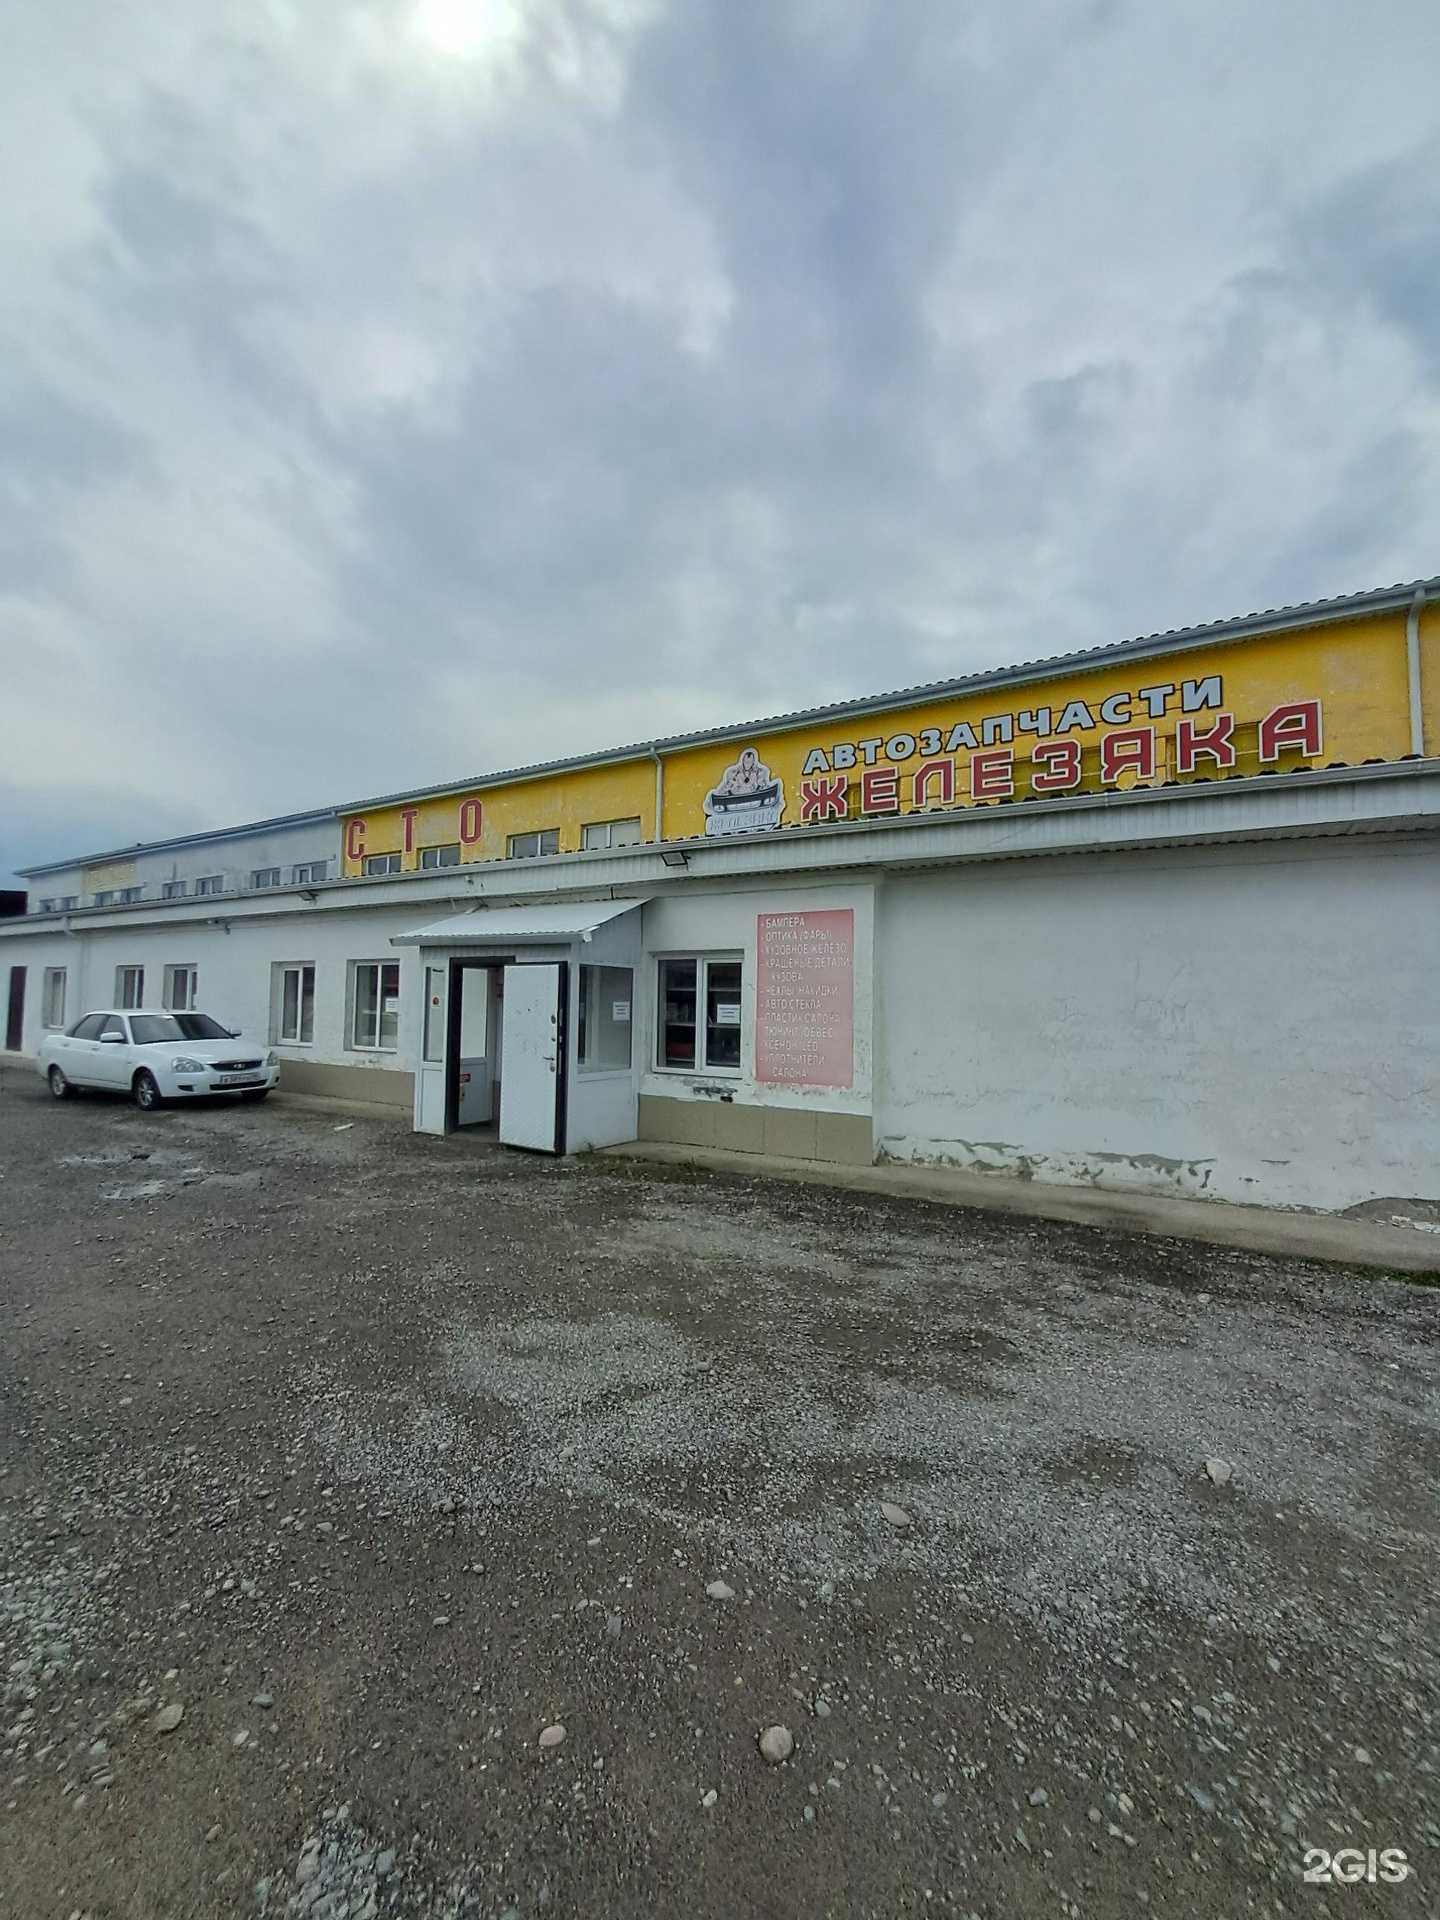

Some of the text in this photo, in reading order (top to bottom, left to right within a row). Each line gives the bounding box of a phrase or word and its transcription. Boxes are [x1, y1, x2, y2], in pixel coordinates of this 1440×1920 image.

[800, 698, 1323, 822] ЖЕЛЕЗЯКА
[802, 674, 1223, 775] АВТОЗАПЧАСТИ
[347, 798, 483, 860] СТО
[765, 917, 805, 928] БАМПЕРА
